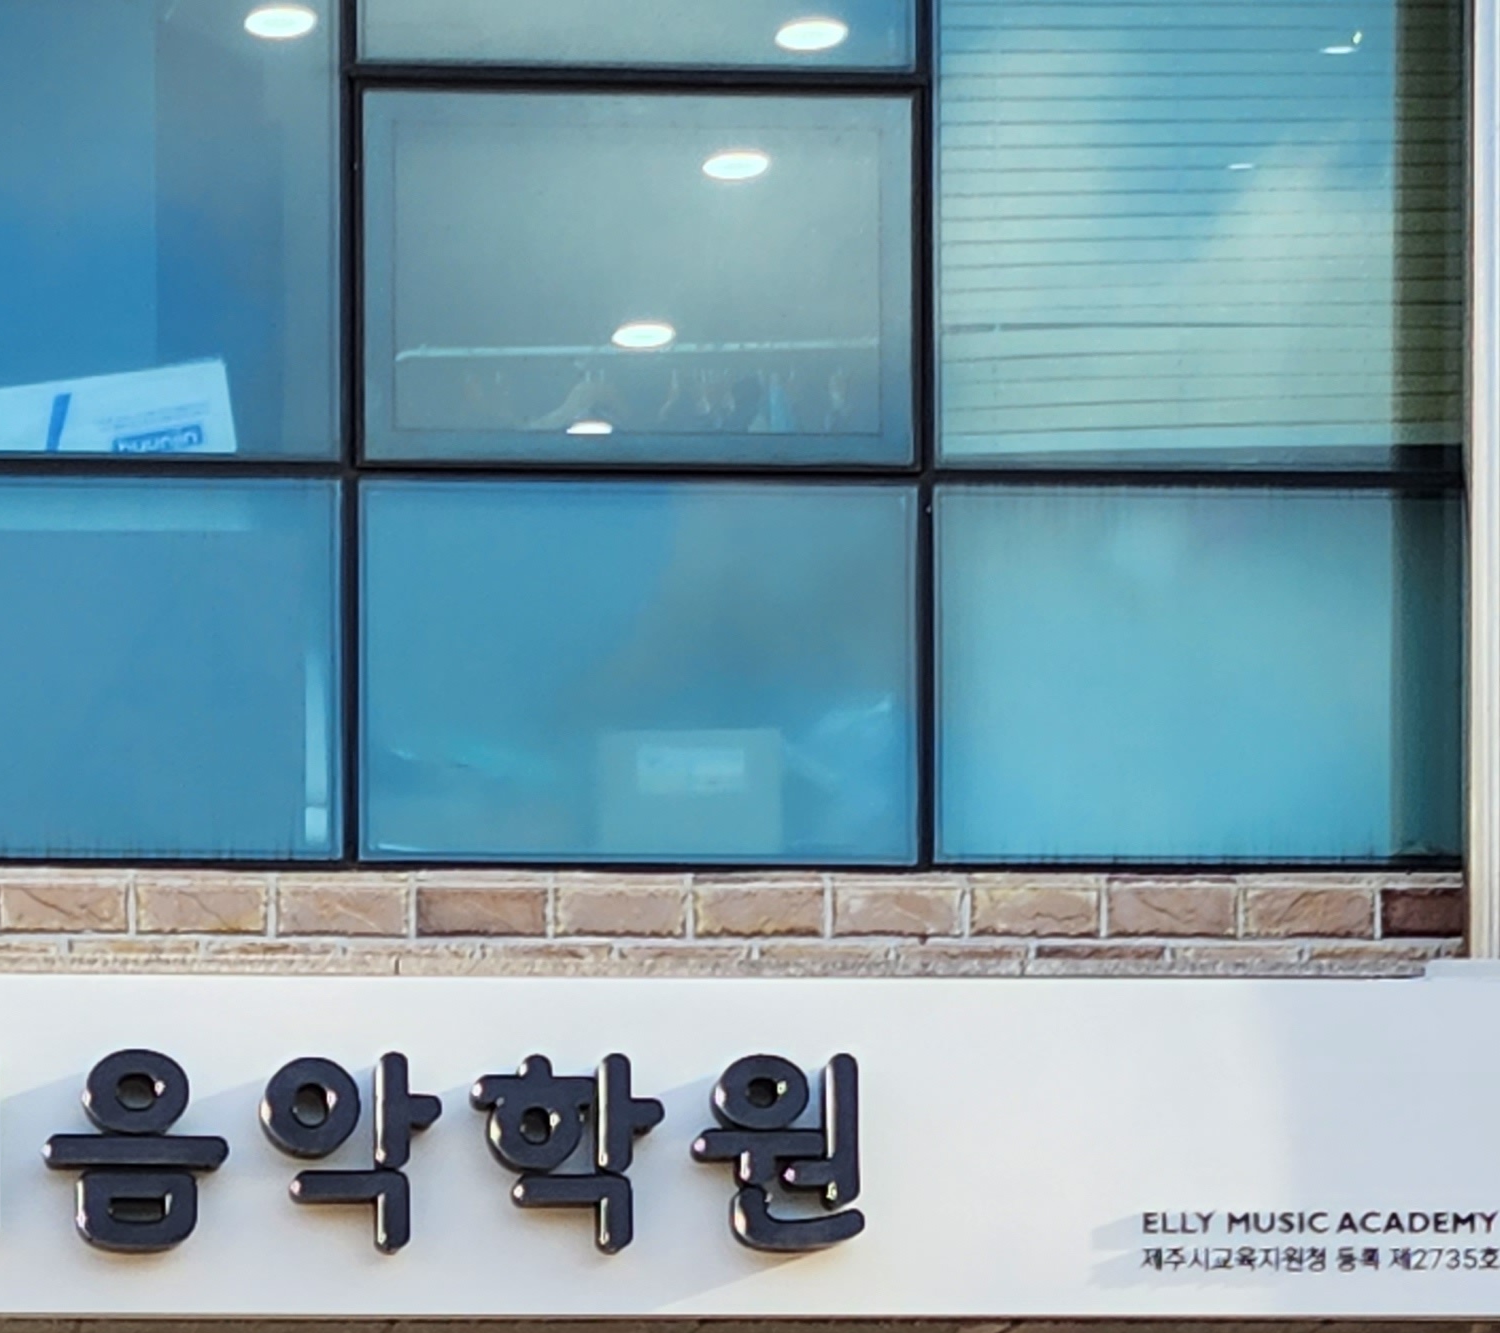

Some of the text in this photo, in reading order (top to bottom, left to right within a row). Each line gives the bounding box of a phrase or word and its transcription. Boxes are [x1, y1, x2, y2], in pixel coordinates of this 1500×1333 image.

[1142, 1210, 1498, 1234] ELLY MUSIC ACADEMY
[1140, 1246, 1500, 1272] 제주시교육지원청 등록 제2735호
